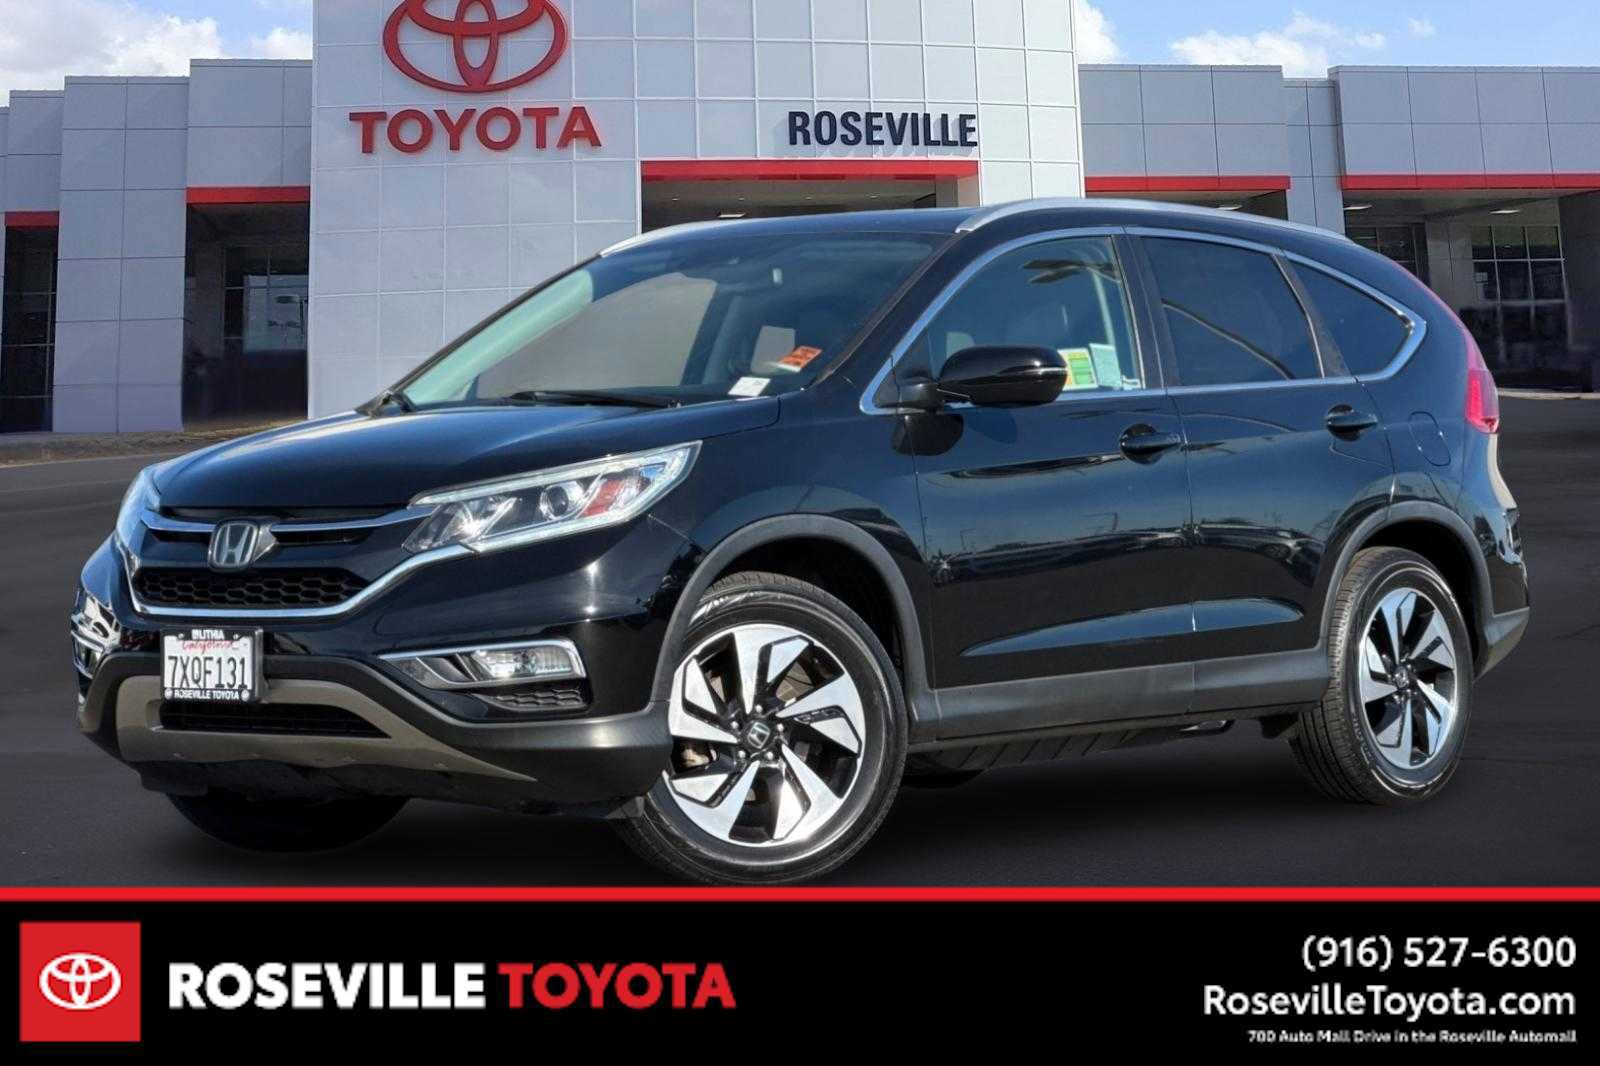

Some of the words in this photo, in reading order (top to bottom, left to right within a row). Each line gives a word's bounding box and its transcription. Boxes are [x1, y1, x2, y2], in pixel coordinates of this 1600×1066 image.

[349, 106, 602, 153] TOYOTA
[788, 110, 978, 148] ROSEVILLE
[167, 656, 248, 689] 7XQF131
[174, 689, 212, 699] ROSEVILLE
[213, 689, 240, 700] TOYOTA
